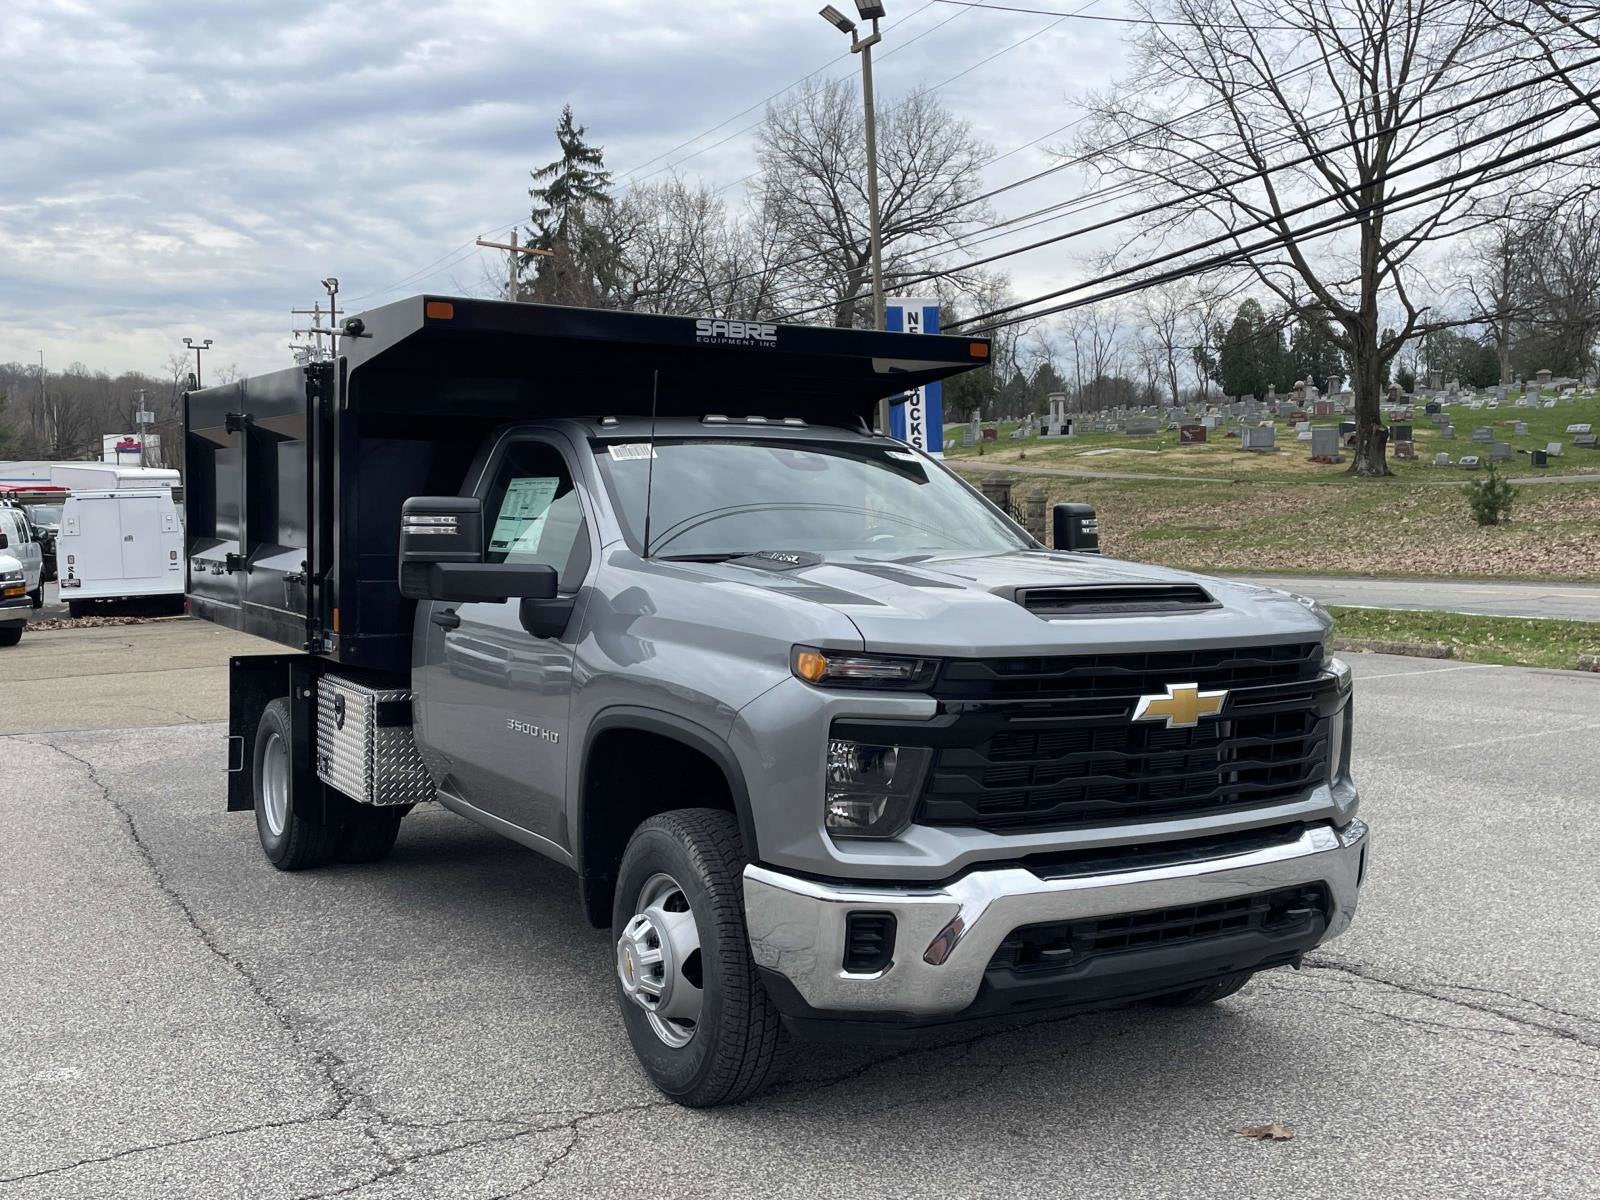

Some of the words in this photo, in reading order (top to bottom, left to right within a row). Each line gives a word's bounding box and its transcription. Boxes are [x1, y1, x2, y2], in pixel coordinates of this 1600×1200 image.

[696, 319, 778, 341] SABRE
[696, 336, 755, 346] EQUIPMENT
[909, 387, 922, 449] UCKS
[505, 718, 539, 737] 3500
[541, 728, 560, 744] HD
